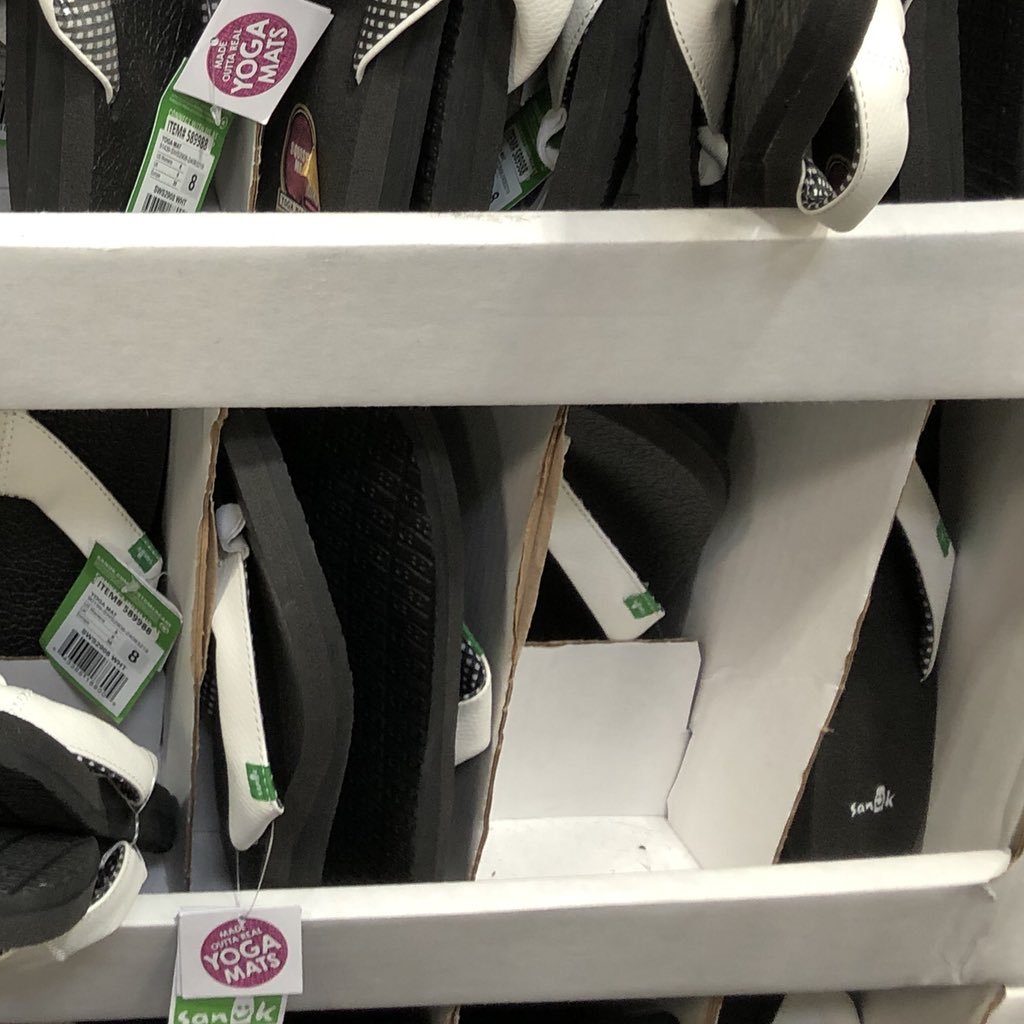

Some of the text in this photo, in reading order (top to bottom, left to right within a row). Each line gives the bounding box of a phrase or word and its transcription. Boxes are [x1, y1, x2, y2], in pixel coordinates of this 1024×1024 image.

[214, 39, 228, 69] MADE
[222, 28, 242, 82] OUTTA REAL
[231, 18, 270, 94] YOGA
[258, 26, 289, 84] MATS
[166, 120, 209, 151] ITEM# 589988
[188, 174, 198, 191] 8
[97, 581, 122, 608] ITEM#
[122, 605, 153, 636] 589988
[128, 649, 140, 664] 8
[203, 934, 282, 971] YOGA
[211, 927, 263, 951] OUTTA REAL
[224, 953, 281, 984] MATS
